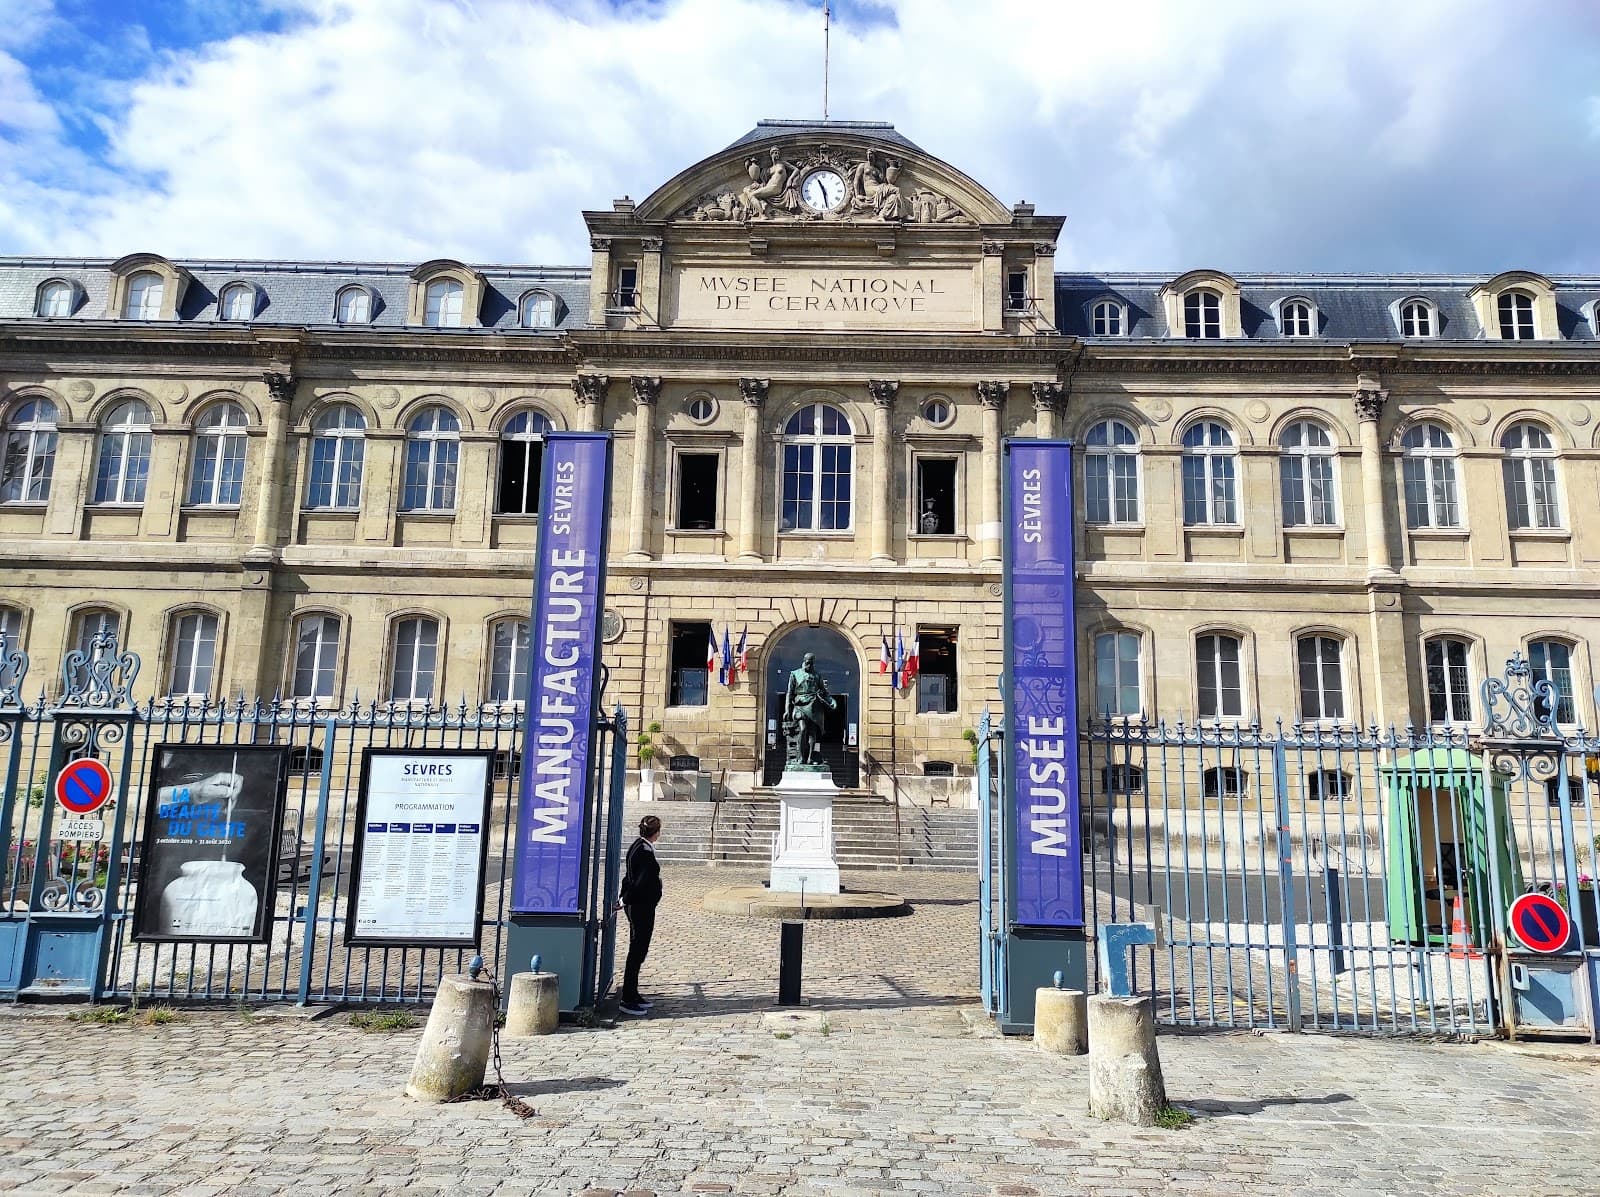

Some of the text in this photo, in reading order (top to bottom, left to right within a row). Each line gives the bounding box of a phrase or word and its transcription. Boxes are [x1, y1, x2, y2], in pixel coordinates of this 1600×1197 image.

[700, 276, 945, 294] MVSEE NATIONAL
[716, 295, 927, 314] DE CERAMIQVE
[548, 461, 574, 535] SÈVRES
[1017, 468, 1042, 543] SÈVRES
[531, 548, 586, 845] MANUFACTURE
[403, 760, 454, 776] SÈVRES
[1018, 715, 1068, 857] MUSÉE
[171, 788, 191, 803] LA
[394, 803, 455, 811] PROGRAMMATION
[59, 830, 101, 839] POMPIERS
[168, 821, 193, 837] DU
[197, 821, 246, 839] GESTE
